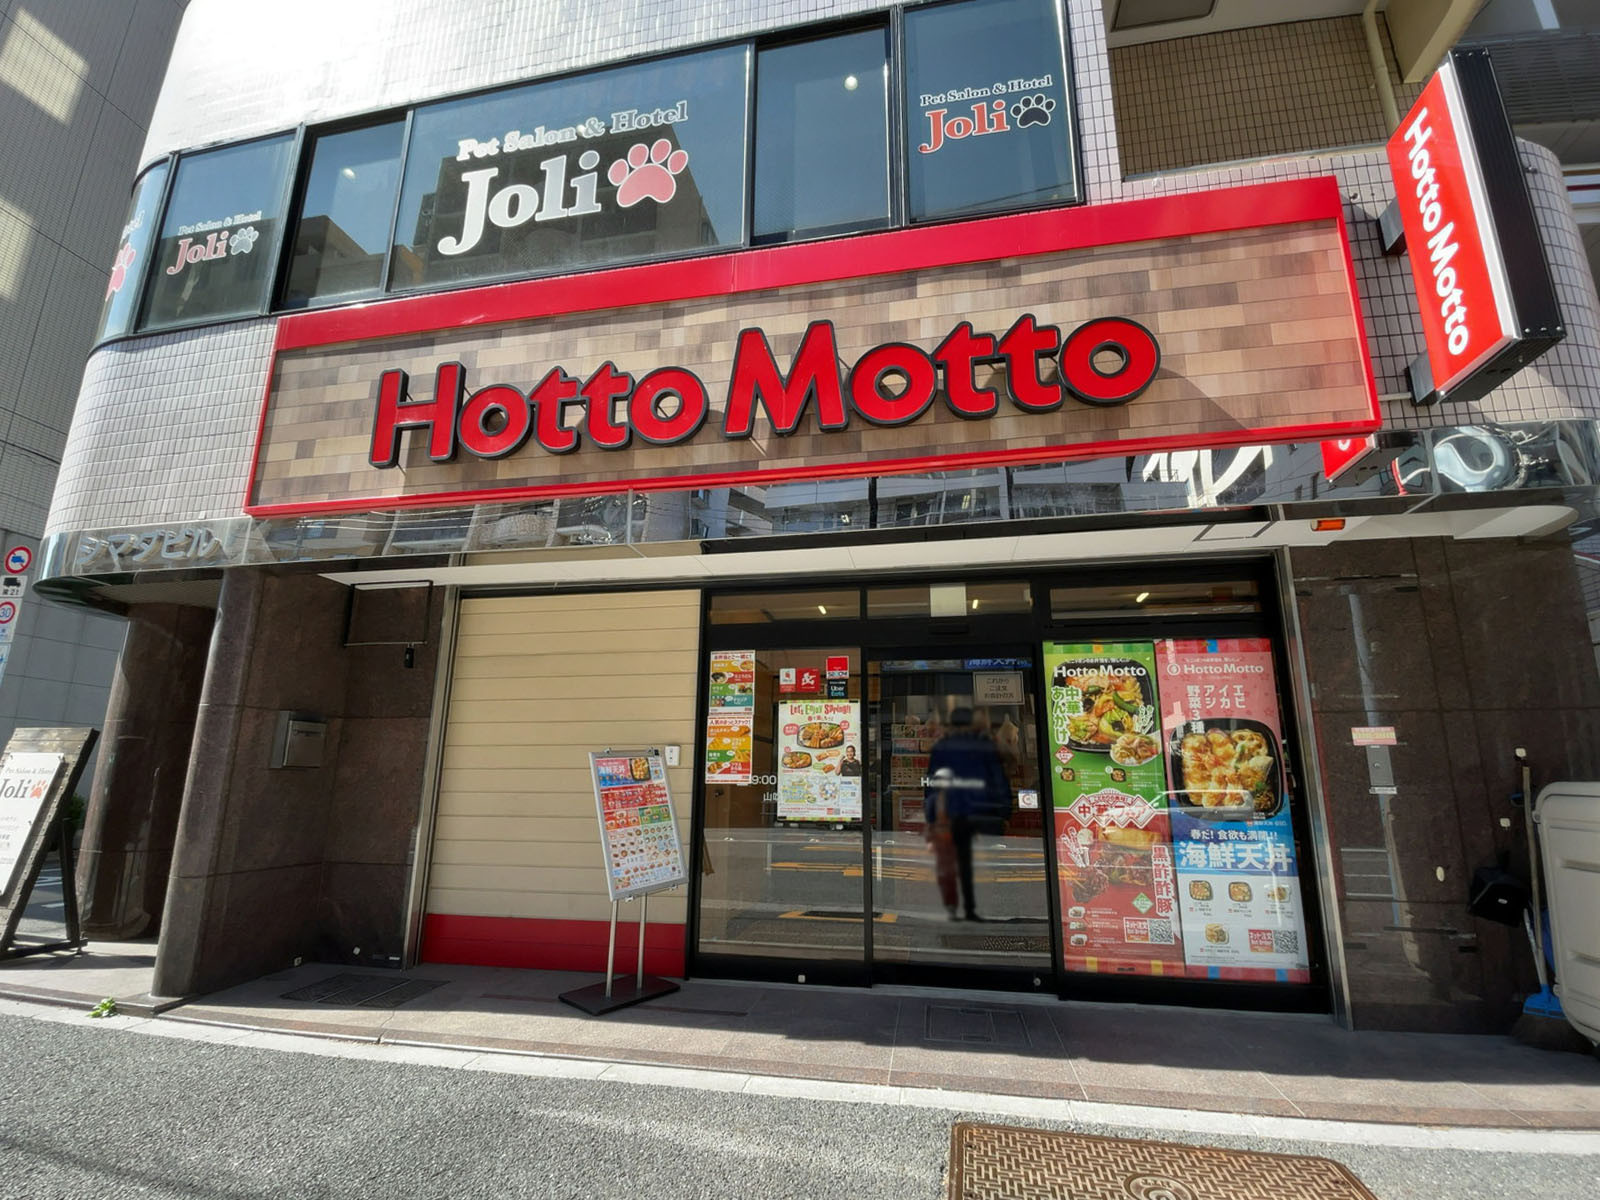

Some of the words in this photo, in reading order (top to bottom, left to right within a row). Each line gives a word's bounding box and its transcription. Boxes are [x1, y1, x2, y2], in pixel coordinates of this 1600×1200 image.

[920, 94, 946, 107] Pet
[947, 87, 990, 103] Salon
[992, 83, 1006, 95] &
[1008, 74, 1053, 92] Hotel
[456, 138, 500, 162] Pet
[503, 125, 577, 152] Salon
[582, 117, 605, 138] &
[610, 100, 688, 134] Hotel
[918, 99, 1010, 153] Joli
[437, 150, 602, 255] Joli
[166, 230, 230, 275] Joli
[1404, 107, 1441, 232] Hotto
[1427, 222, 1469, 355] Motto
[368, 359, 710, 469] Hotto
[723, 313, 1162, 441] Motto
[1054, 666, 1098, 677] Hotto
[1099, 665, 1146, 676] Motto
[1184, 664, 1222, 674] Hotto
[1224, 663, 1264, 673] Motto
[1052, 687, 1070, 744] あんかけ
[1065, 687, 1083, 714] 中華
[1153, 846, 1174, 913] 黒酢酢豚
[1179, 841, 1293, 872] 海鮮天丼
